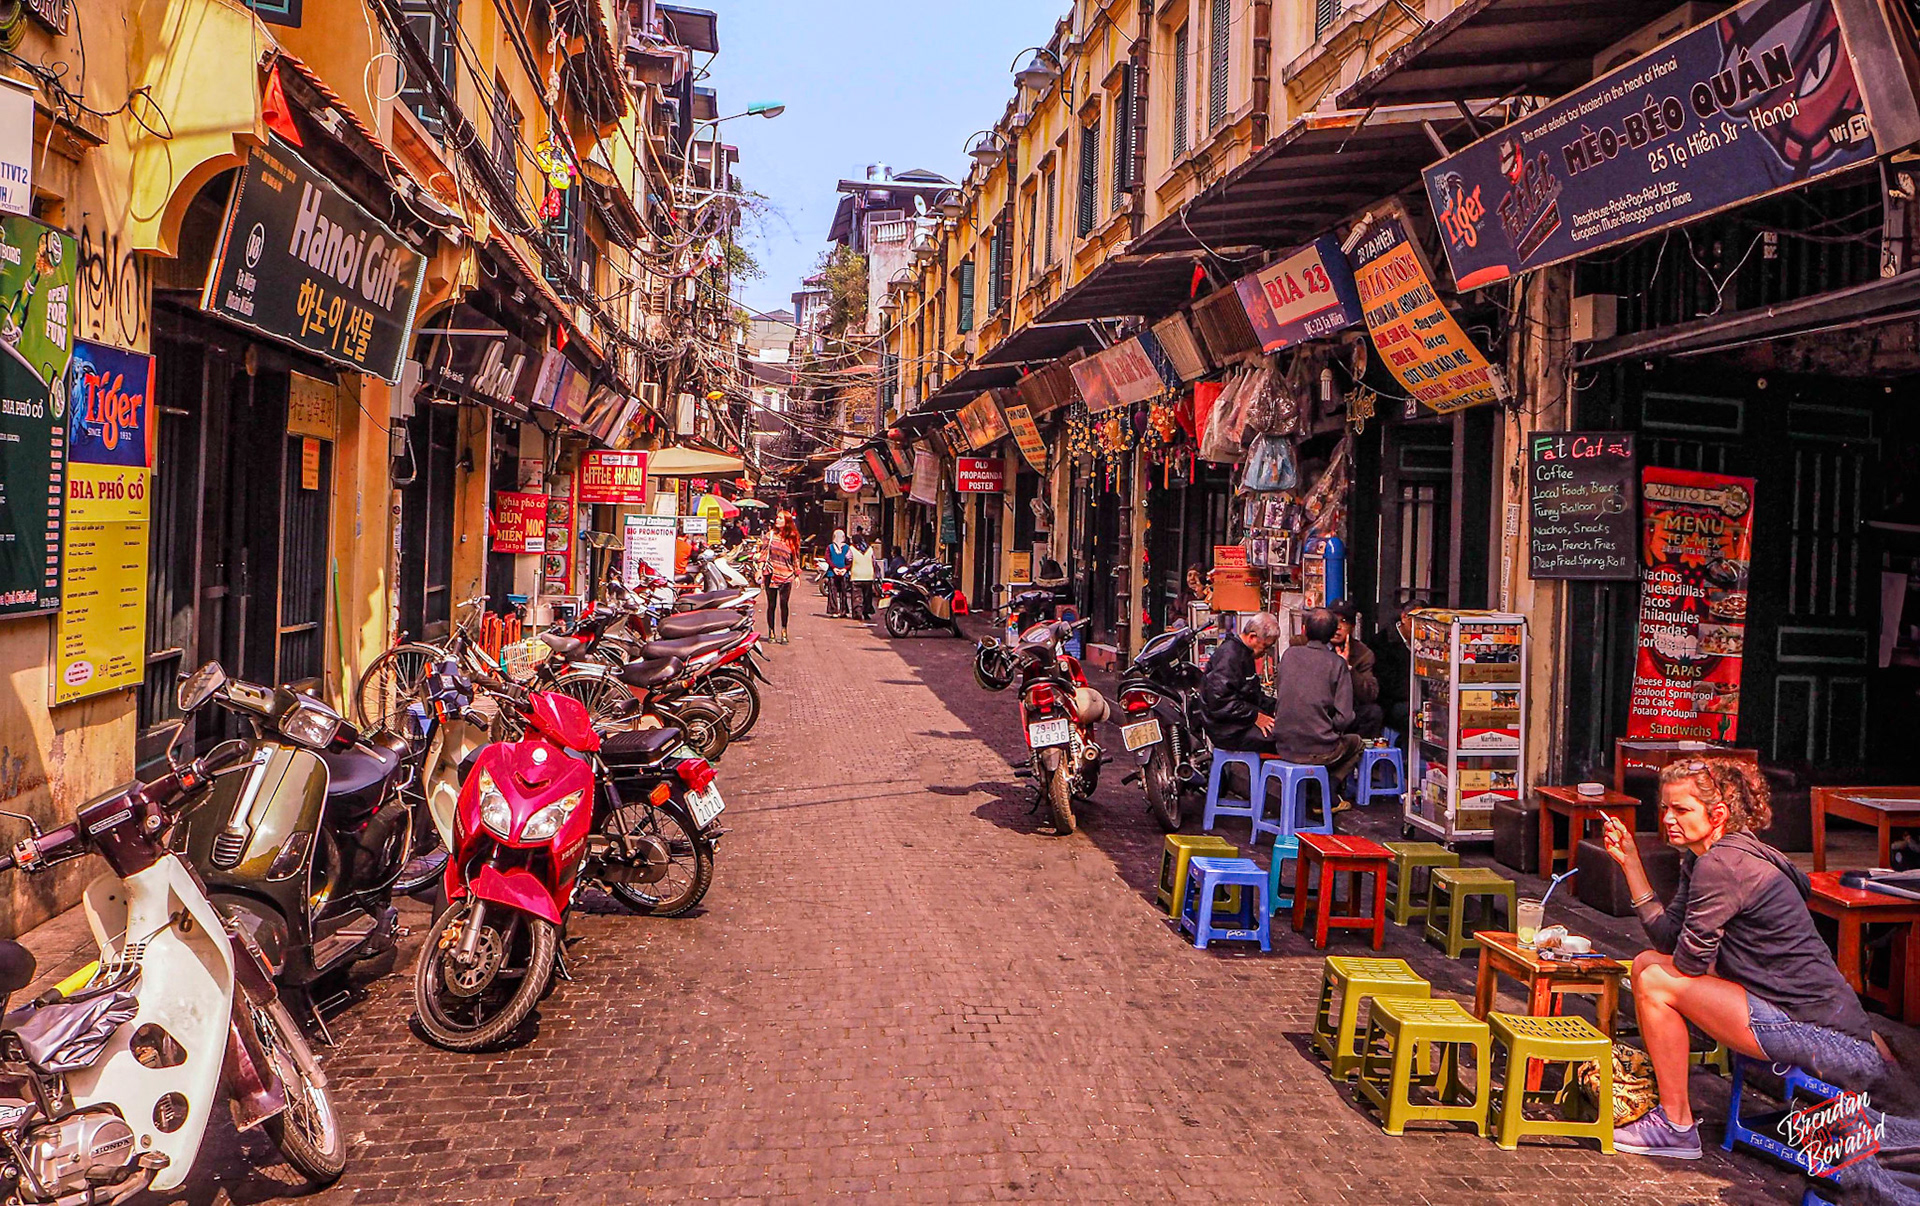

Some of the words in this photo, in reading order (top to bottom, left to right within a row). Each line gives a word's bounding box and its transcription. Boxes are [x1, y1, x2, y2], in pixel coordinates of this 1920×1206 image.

[1521, 131, 1534, 144] The
[1533, 123, 1548, 139] most
[1568, 108, 1580, 124] bar
[1578, 92, 1604, 115] located
[1603, 91, 1612, 105] in
[1611, 85, 1625, 101] the
[1623, 73, 1644, 94] heart
[1644, 66, 1655, 84] of
[1650, 55, 1679, 80] Hanoi
[1562, 93, 1685, 177] MÈO-BÉO
[1690, 42, 1795, 119] QUÁN
[1648, 149, 1668, 174] 25
[1667, 142, 1687, 169] Tạ
[1720, 121, 1739, 146] Str
[1749, 92, 1800, 132] Hanoi
[1440, 184, 1487, 248] Tiger
[1571, 220, 1603, 242] European
[1654, 197, 1671, 214] and
[1671, 191, 1692, 209] more
[249, 234, 262, 260] 18
[288, 181, 367, 290] Hanoi
[361, 235, 401, 312] Gift
[48, 285, 68, 302] OPEN
[1264, 272, 1305, 309] BIA
[1303, 263, 1331, 294] 23
[46, 302, 67, 326] FOR
[296, 278, 347, 350] 하노이
[343, 305, 375, 363] 선물
[46, 320, 67, 352] FUN
[1451, 348, 1472, 366] ME
[84, 371, 143, 450] Tiger
[1534, 437, 1568, 462] Fat
[1571, 437, 1603, 459] Cat
[975, 461, 988, 469] OLD
[1536, 464, 1574, 481] Coffee
[583, 466, 612, 485] LITTLE
[614, 466, 642, 486] HANOI
[960, 471, 1002, 479] PROPAGANDA
[70, 480, 96, 498] BIA
[98, 474, 124, 499] PHỐ
[128, 473, 144, 500] CỔ
[968, 482, 994, 490] POSTER
[1532, 485, 1560, 500] Local
[1562, 483, 1588, 497] Foods,
[1590, 480, 1619, 495] Beers
[500, 509, 523, 524] BÚN
[1534, 502, 1560, 522] Funny
[1560, 502, 1597, 515] Balloon
[496, 525, 523, 541] MIẾN
[639, 528, 674, 536] PROMOTION
[1574, 522, 1610, 535] Snacks
[1664, 514, 1725, 535] MENU
[1594, 538, 1616, 551] Fries
[1667, 533, 1721, 549] TEX-MEX
[1533, 557, 1557, 571] Deep
[1557, 556, 1577, 567] Fried
[1578, 554, 1605, 570] Spring
[1607, 557, 1626, 567] Roll
[1642, 569, 1683, 583] Nachos
[1642, 582, 1706, 598] Quesadillas
[1641, 597, 1671, 608] Tacos
[1640, 608, 1700, 624] Chilaquiles
[1640, 622, 1688, 637] Tostadas
[1665, 664, 1702, 677] TAPAS
[1635, 677, 1663, 686] Cheese
[1665, 679, 1692, 689] Bread
[1634, 687, 1666, 698] Seafood
[1633, 697, 1650, 706] Crab
[1652, 698, 1674, 708] Cake
[1632, 707, 1659, 716] Potato
[1650, 723, 1712, 737] Sandwichs
[699, 796, 721, 822] 2020
[95, 1138, 130, 1154] HONDA
[1750, 1134, 1762, 1146] Fat
[1764, 1140, 1774, 1149] Cat
